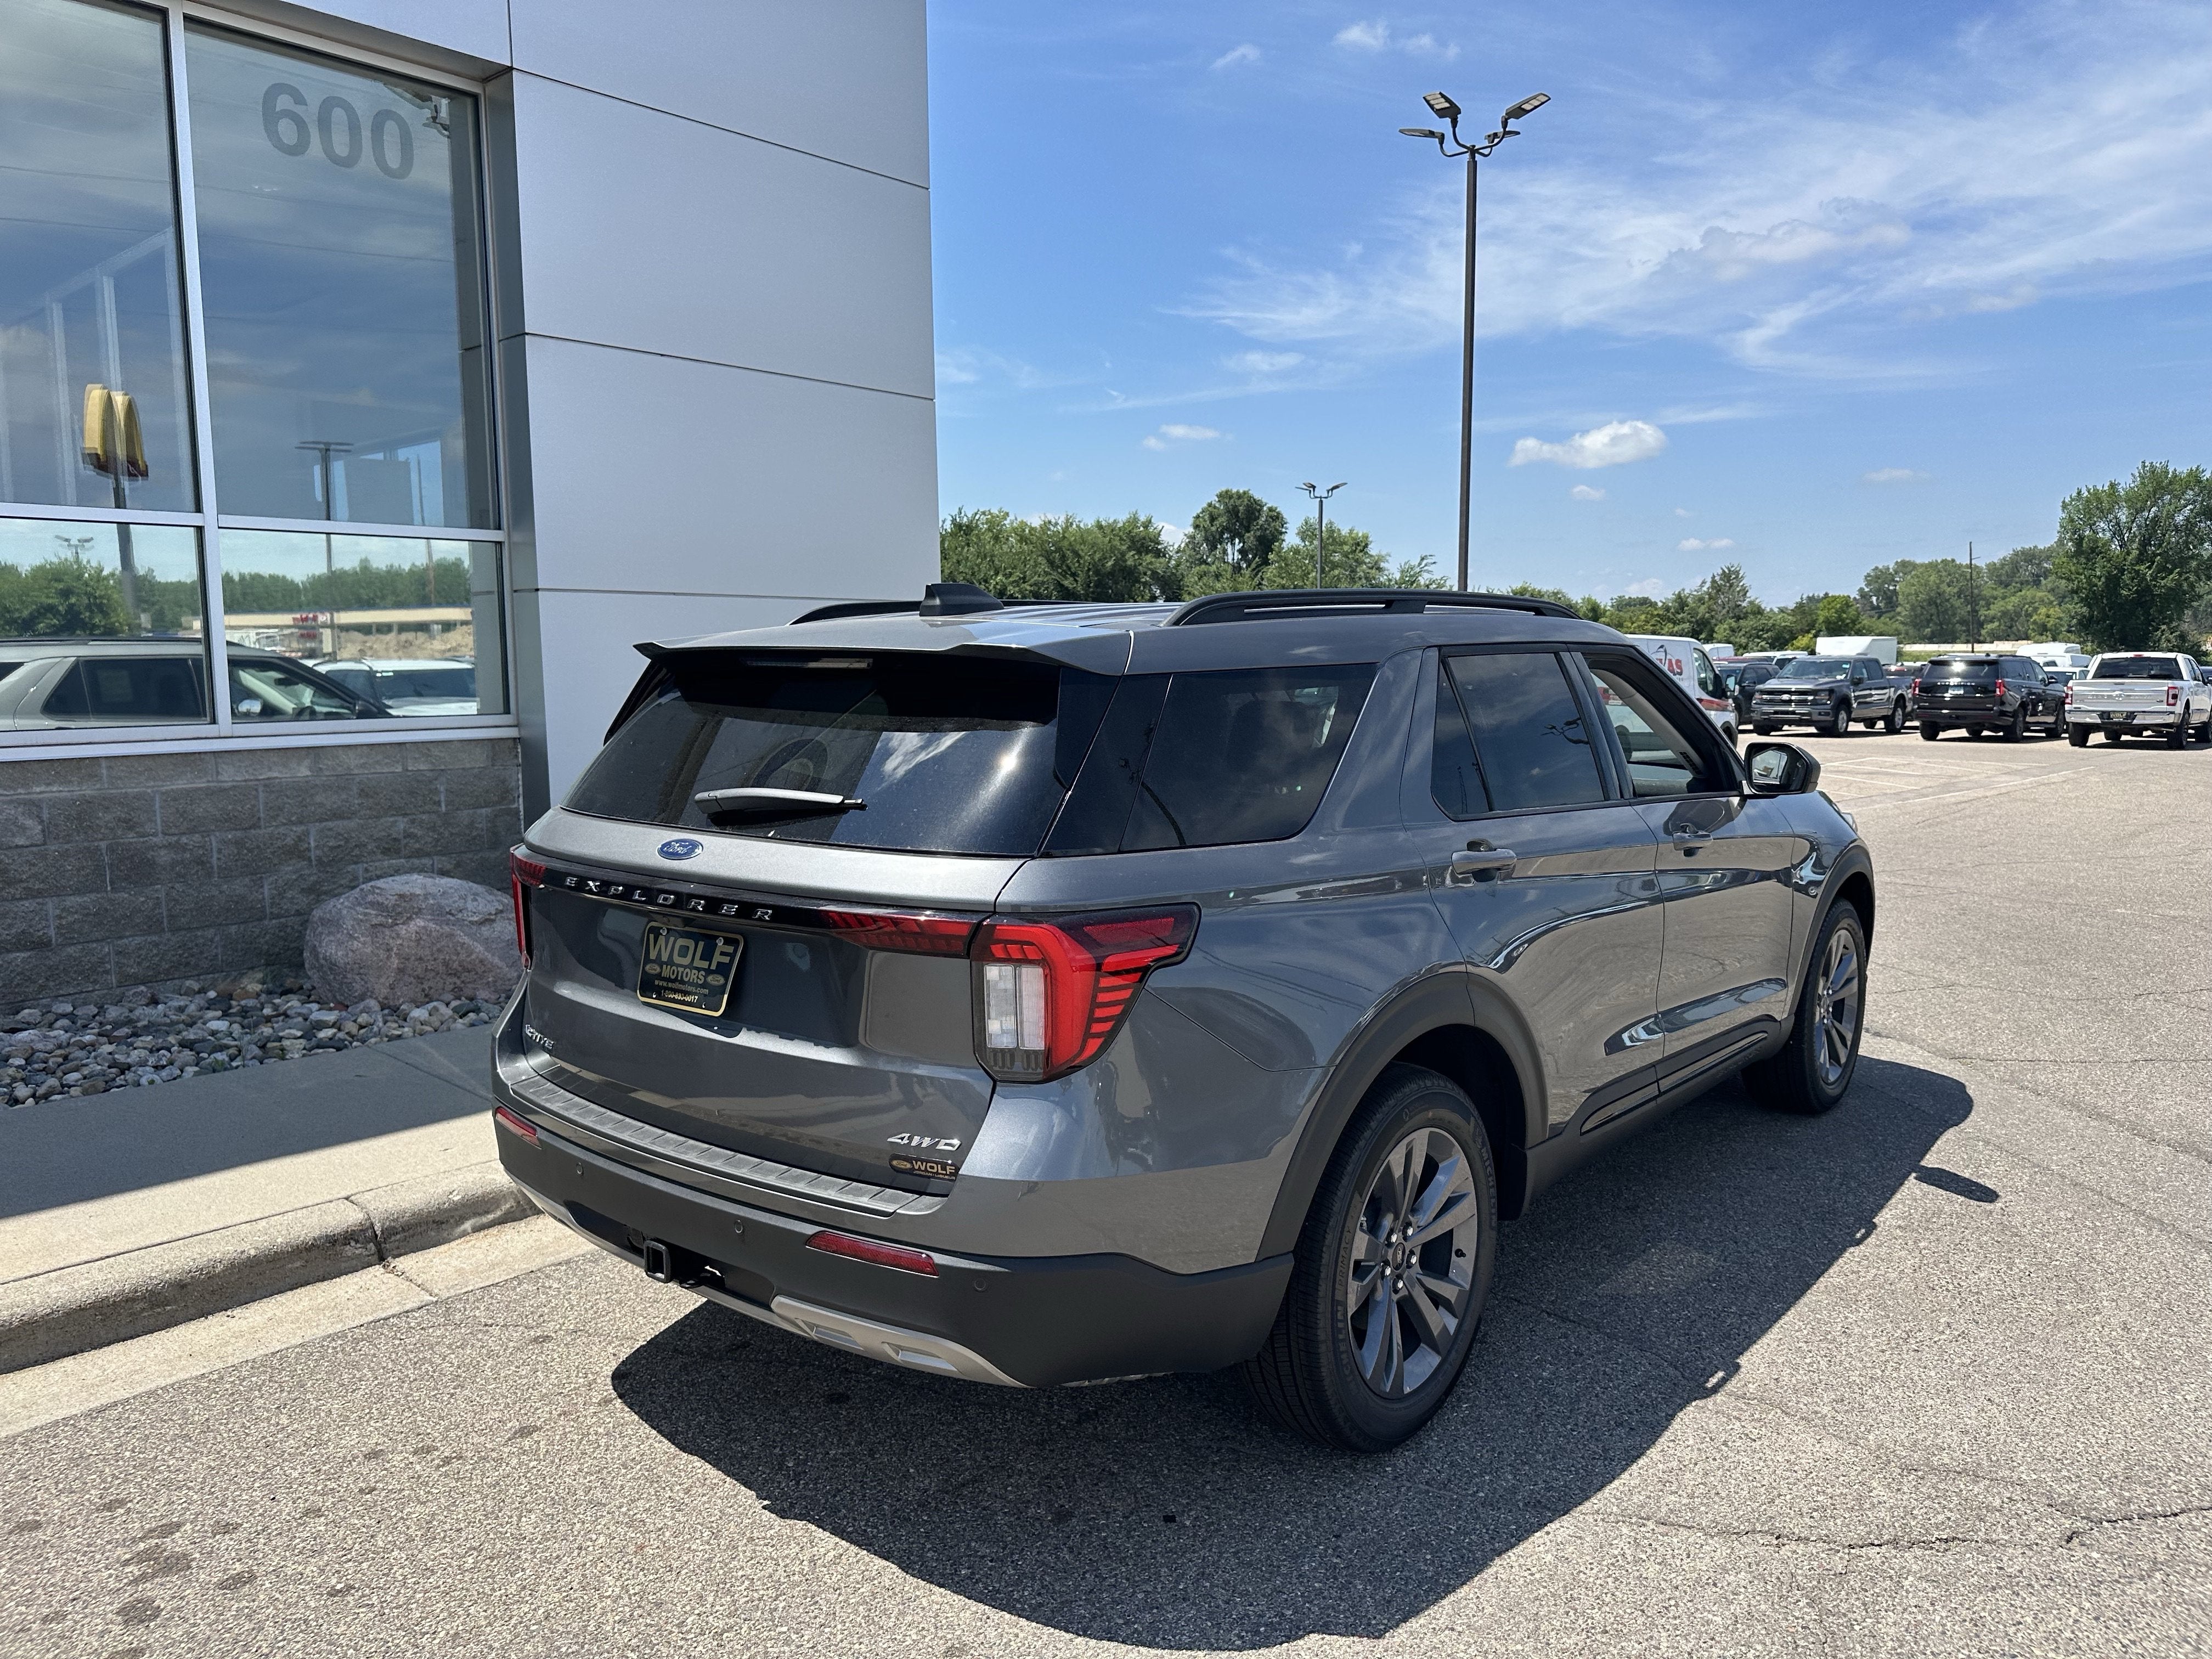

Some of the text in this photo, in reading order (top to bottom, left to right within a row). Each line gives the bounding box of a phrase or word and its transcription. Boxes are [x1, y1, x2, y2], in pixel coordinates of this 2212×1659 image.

[262, 82, 414, 180] 600
[663, 842, 692, 854] Ford
[564, 876, 772, 920] EXPLORER
[649, 933, 735, 970] WOLF
[662, 964, 706, 984] MOTORS
[887, 1133, 962, 1151] 4WD
[912, 1160, 955, 1174] WOLF
[1338, 1224, 1352, 1287] PRIMACY
